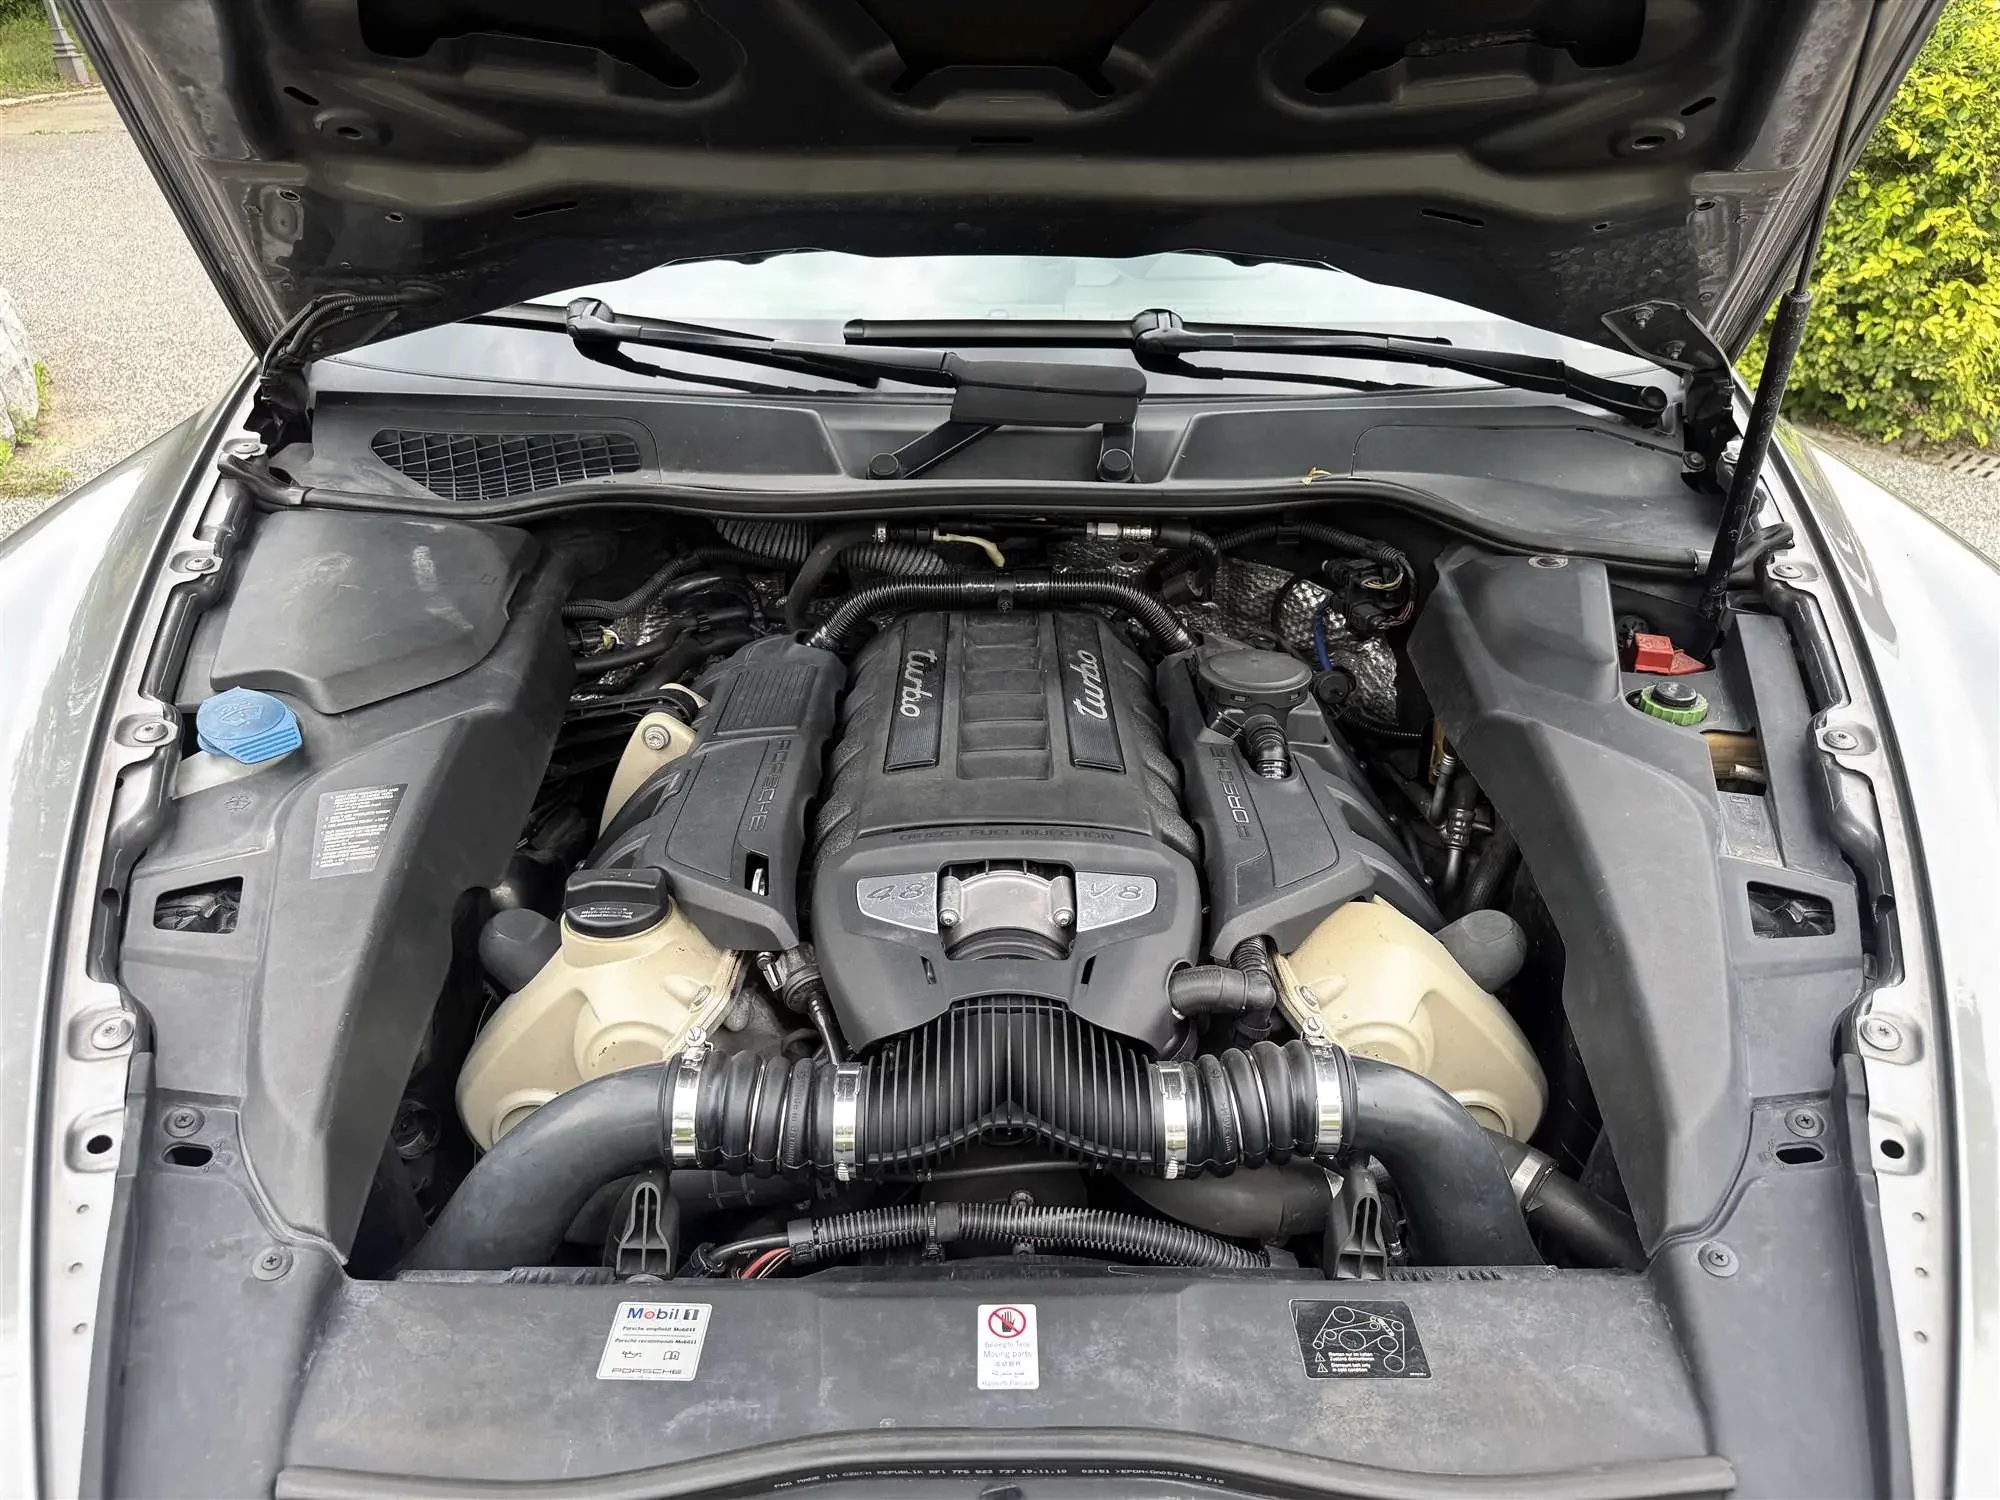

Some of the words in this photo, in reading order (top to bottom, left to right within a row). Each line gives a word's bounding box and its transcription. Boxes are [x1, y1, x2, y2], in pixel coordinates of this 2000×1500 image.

[900, 649, 938, 718] turbo
[1069, 649, 1108, 720] turbo
[747, 739, 792, 832] PORSCHE
[1087, 882, 1143, 901] V8
[627, 1307, 679, 1320] Mobil
[983, 1350, 1011, 1359] Moving
[1012, 1351, 1033, 1359] parts
[611, 1367, 682, 1375] PORSCHE
